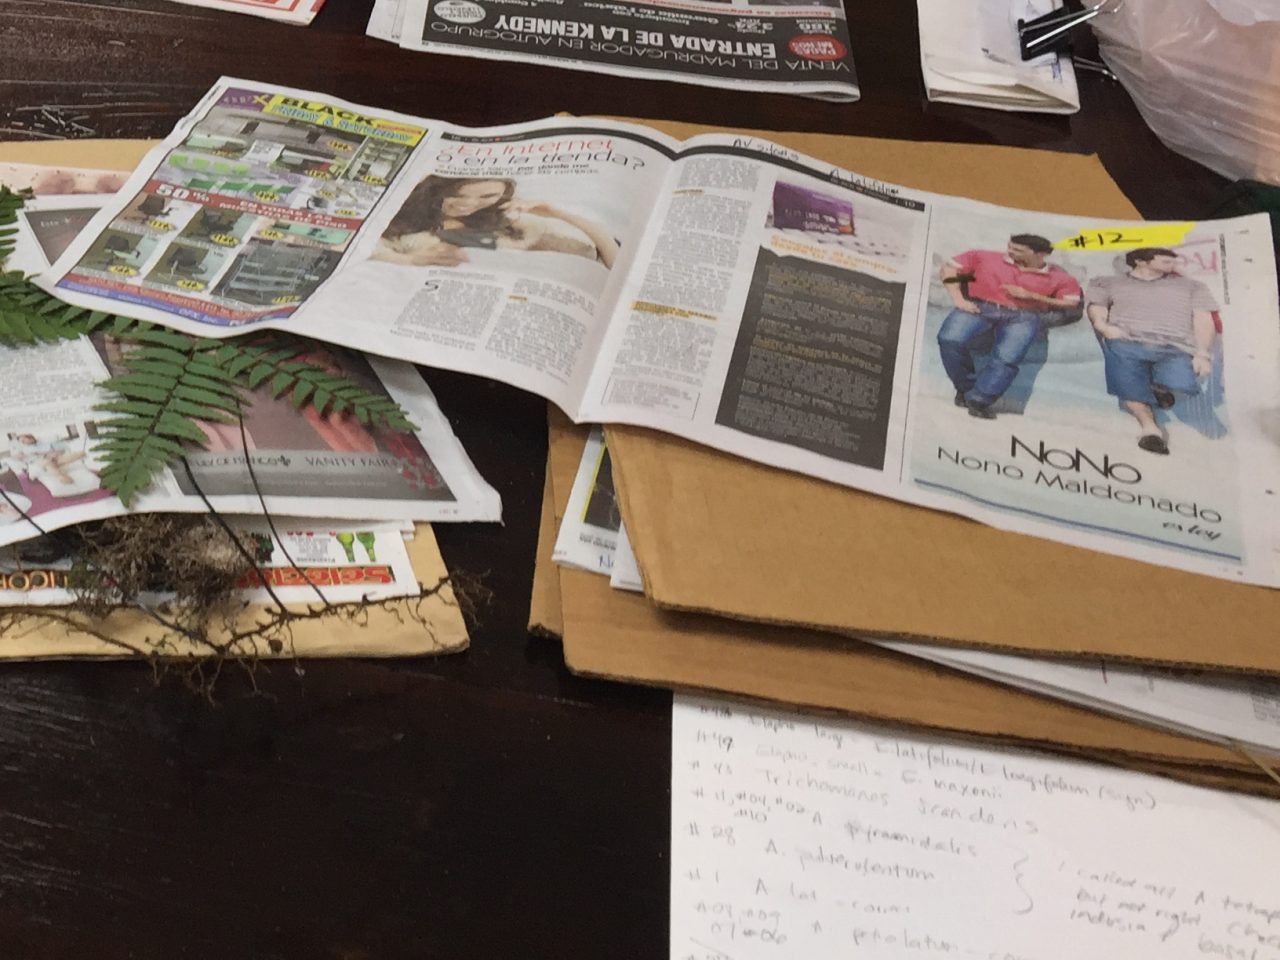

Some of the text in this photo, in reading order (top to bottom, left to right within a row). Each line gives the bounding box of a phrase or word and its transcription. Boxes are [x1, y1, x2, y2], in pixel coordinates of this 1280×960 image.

[430, 21, 851, 73] VENTA DEL MADRUGADOR EN AUTOGRUPO
[493, 14, 777, 59] ENTRADA DE LA KENNEDY
[280, 96, 374, 125] BLACK
[463, 155, 498, 166] en
[508, 155, 530, 164] la
[542, 150, 646, 170] tienda?
[155, 184, 191, 200] 50
[1068, 231, 1143, 249] #12
[305, 455, 358, 467] VANITY
[937, 445, 1223, 523] Nono Maldonado
